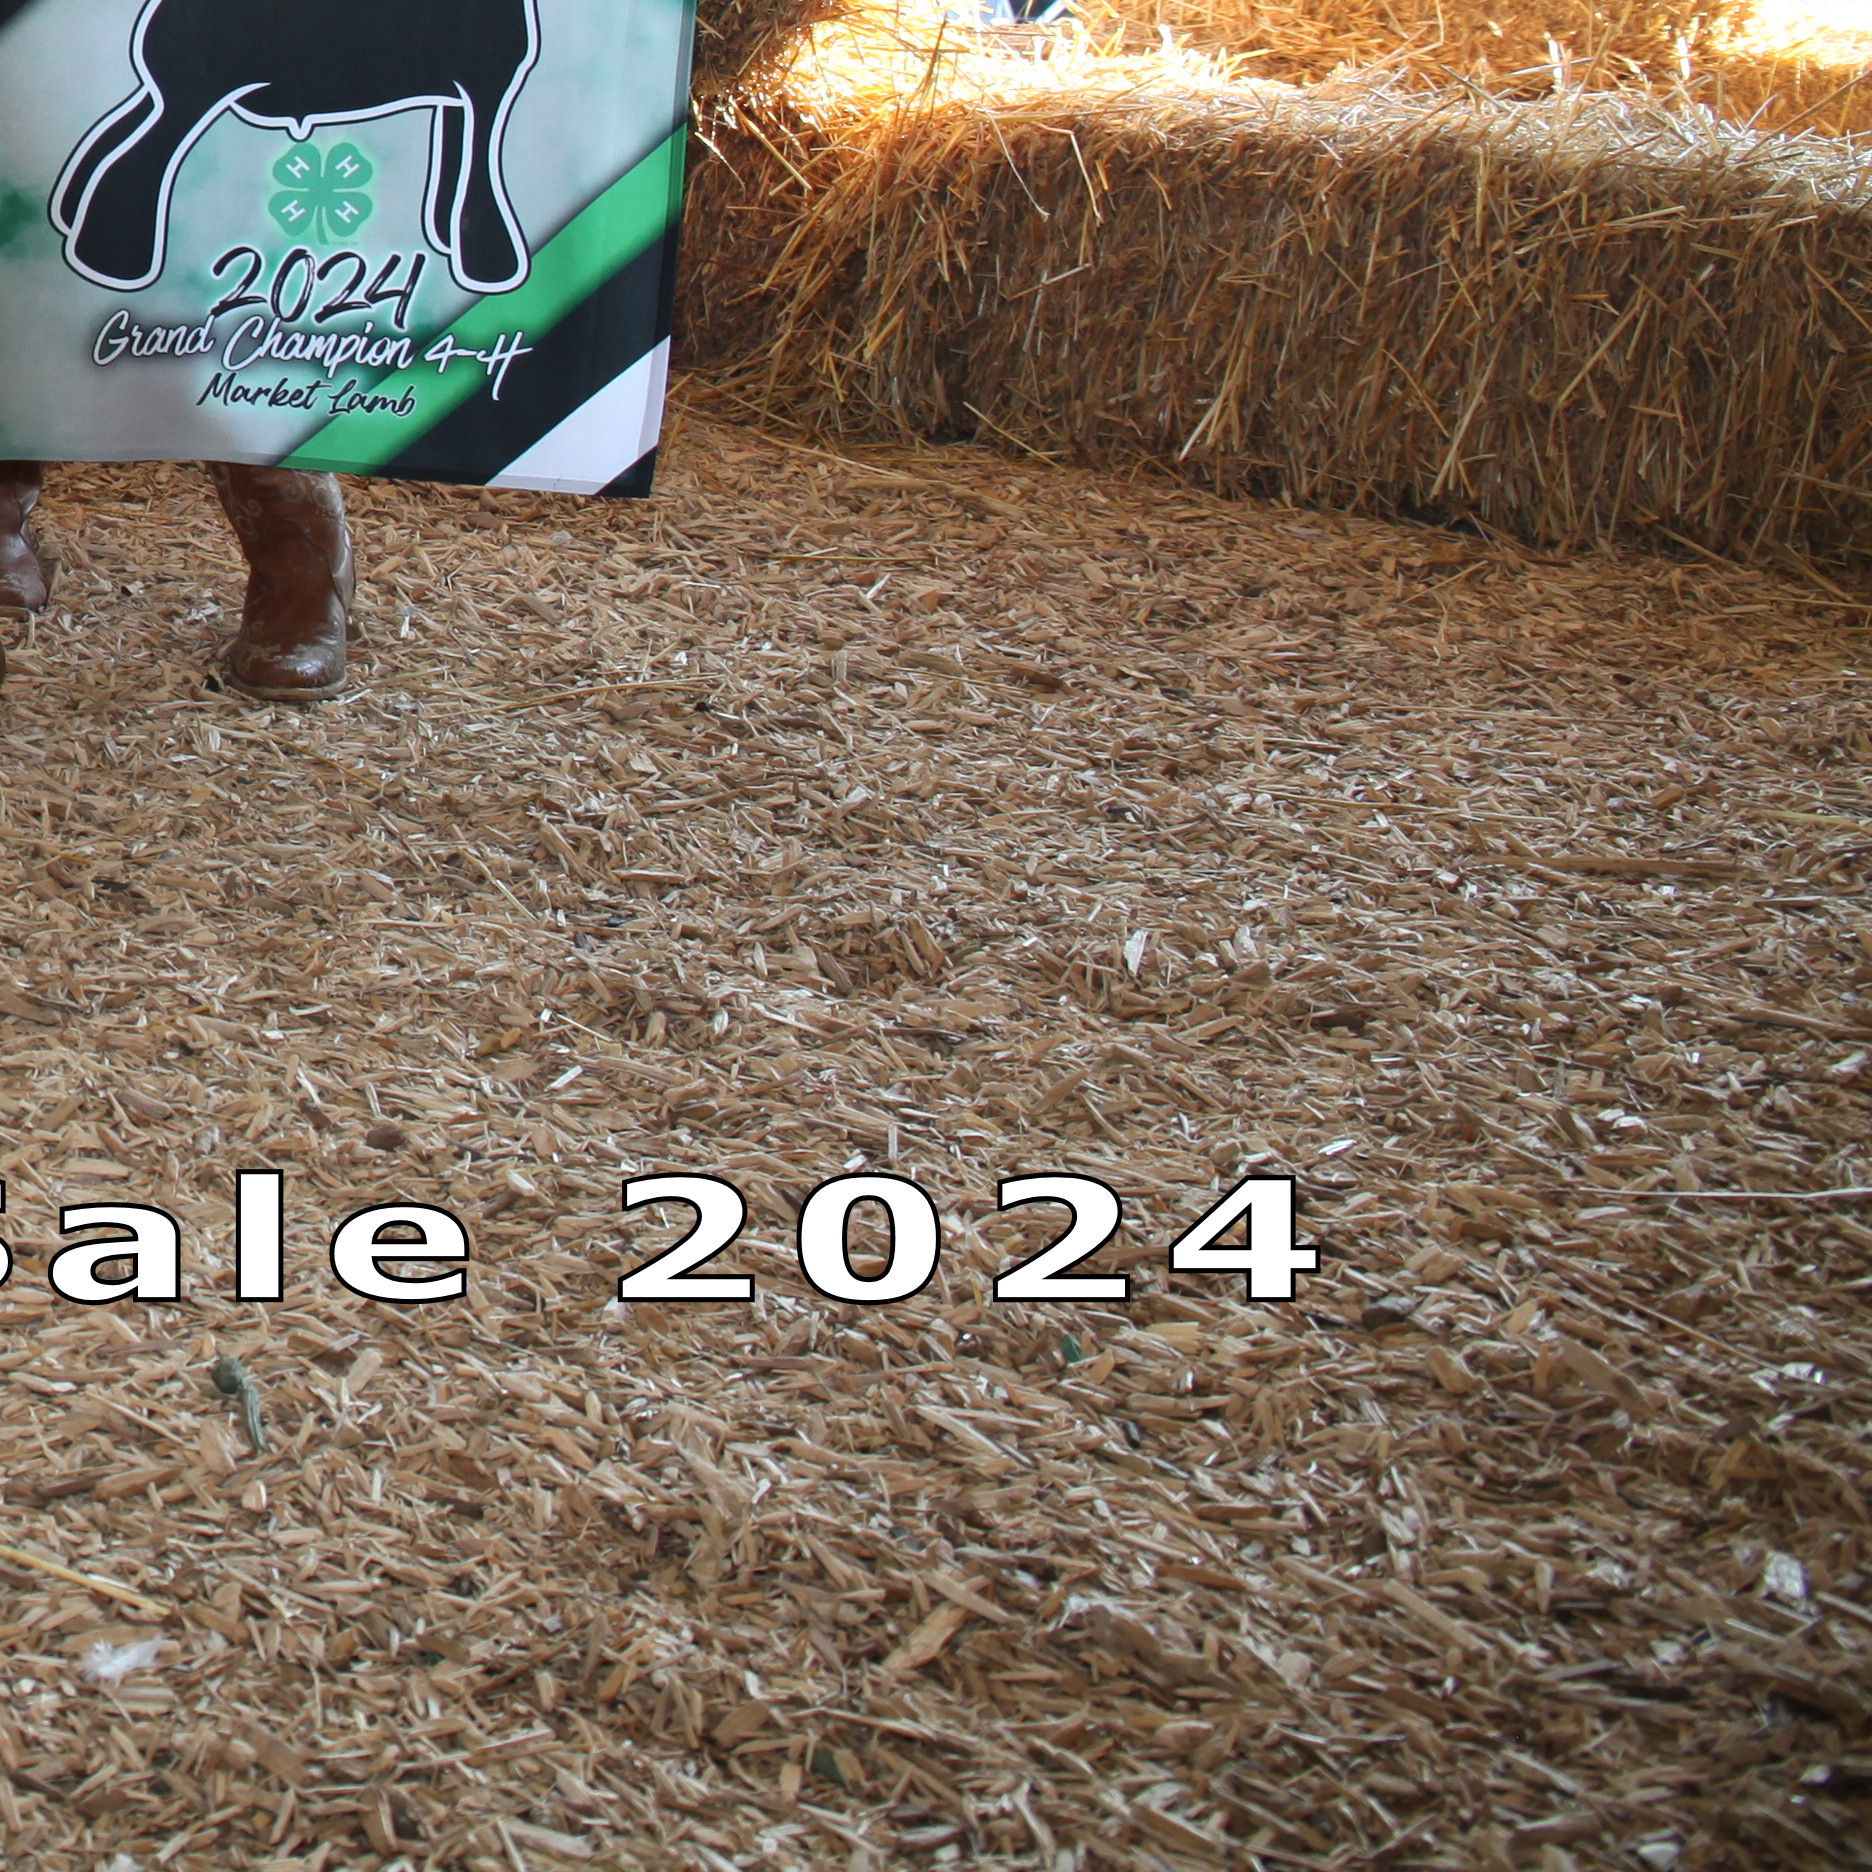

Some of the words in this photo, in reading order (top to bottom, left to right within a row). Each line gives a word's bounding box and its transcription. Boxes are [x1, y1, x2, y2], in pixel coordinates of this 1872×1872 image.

[285, 155, 311, 179] H
[335, 155, 361, 179] H
[281, 199, 307, 223] H
[334, 200, 360, 224] H
[211, 246, 426, 330] 2024
[92, 309, 216, 367] Grand
[221, 315, 415, 379] Champion
[424, 331, 534, 401] 4-H
[195, 372, 332, 410] Market
[327, 378, 416, 417] Lamb
